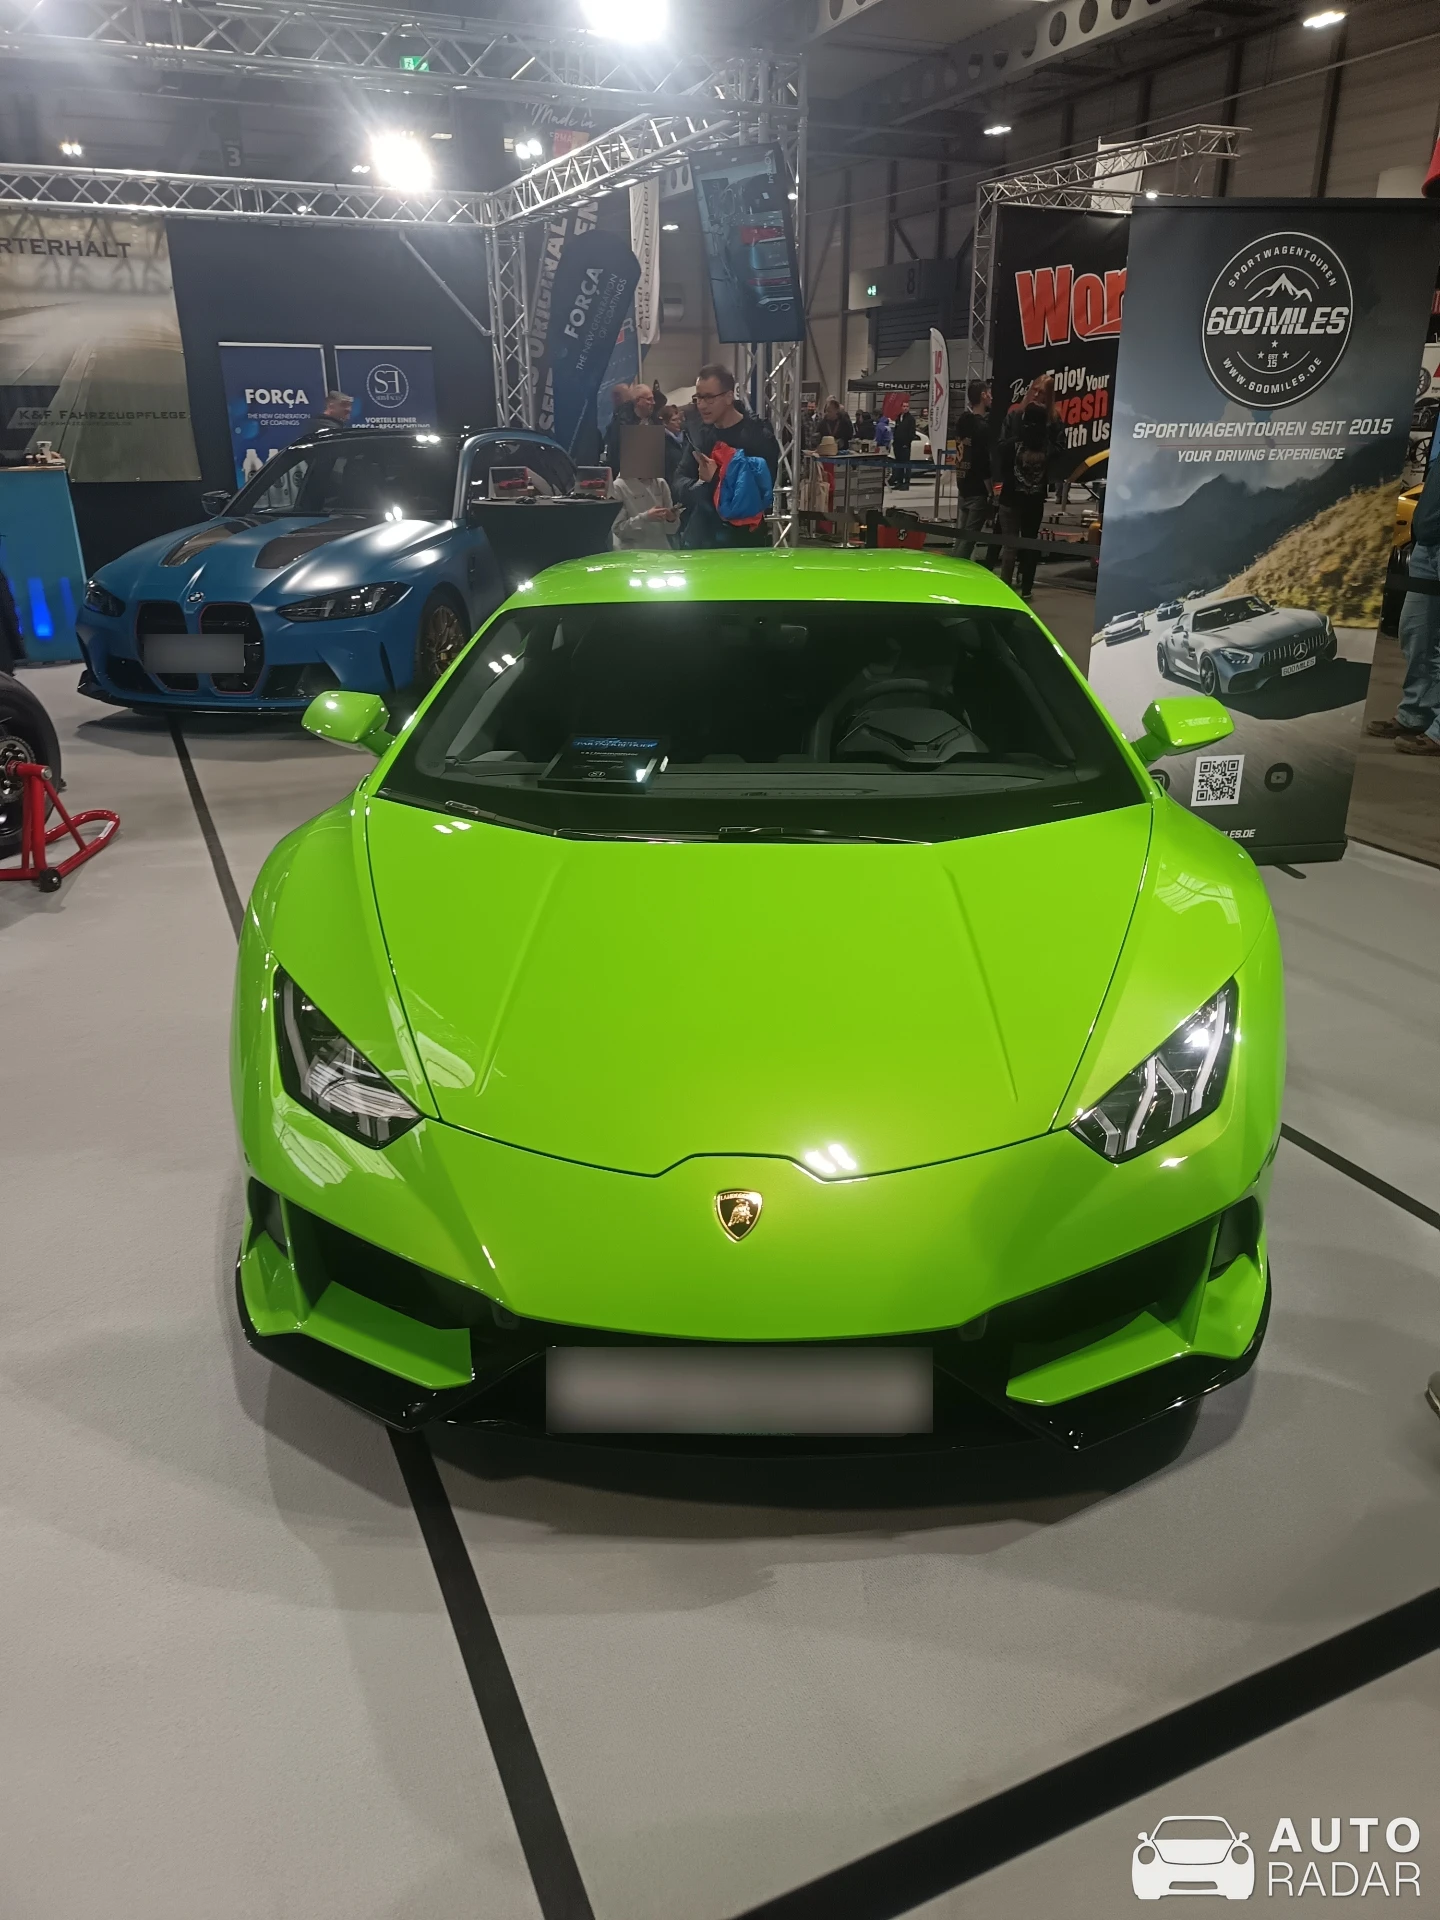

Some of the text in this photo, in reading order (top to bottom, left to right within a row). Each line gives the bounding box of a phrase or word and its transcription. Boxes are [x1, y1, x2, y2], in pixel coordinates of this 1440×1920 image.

[226, 146, 241, 167] 3
[1228, 245, 1338, 288] SPORTWAGENTOUREN
[906, 268, 916, 295] 8
[564, 268, 604, 339] FORÇA
[576, 354, 588, 371] THE
[582, 331, 595, 353] NEW
[1267, 359, 1277, 368] 15
[1086, 375, 1110, 392] Your
[1222, 356, 1322, 394] WWW.600MILES.DE
[245, 388, 310, 409] FORÇA
[19, 410, 52, 421] K&F
[1092, 419, 1110, 443] Us
[1132, 418, 1394, 439] SPORTWAGENTOUREN SEIT 2015
[1177, 447, 1346, 463] YOUR DRIVING EXPERIENCE
